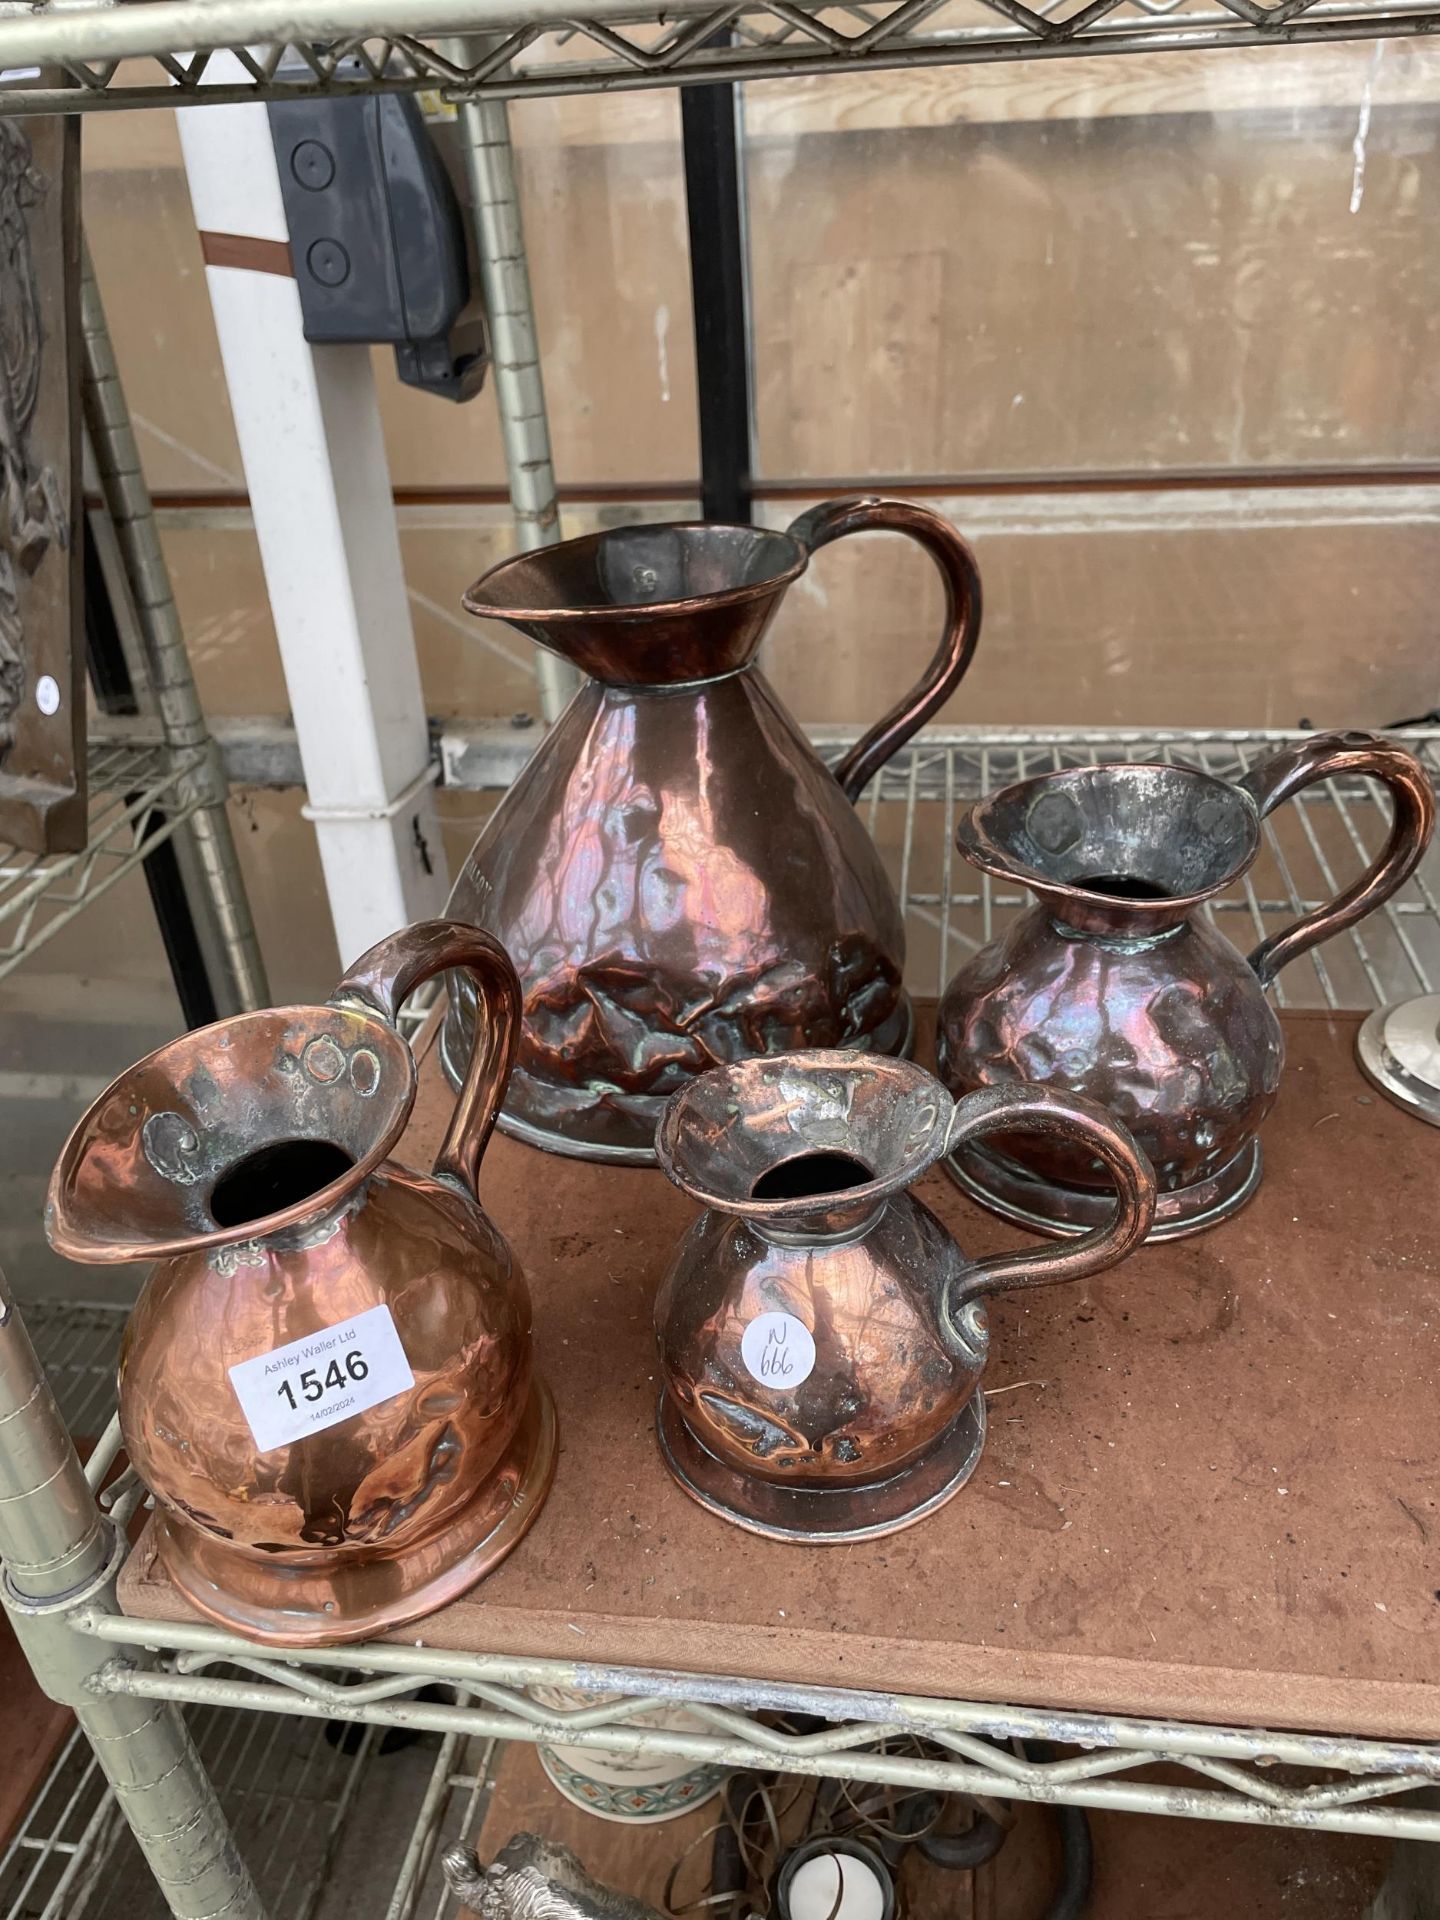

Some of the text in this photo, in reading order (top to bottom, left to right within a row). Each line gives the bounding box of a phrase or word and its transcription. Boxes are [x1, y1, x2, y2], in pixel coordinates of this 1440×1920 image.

[265, 1329, 356, 1375] Ashley Waller Ltd
[761, 1345, 793, 1376] 666
[277, 1350, 369, 1410] 1546
[311, 1397, 355, 1421] 14/02/2024
